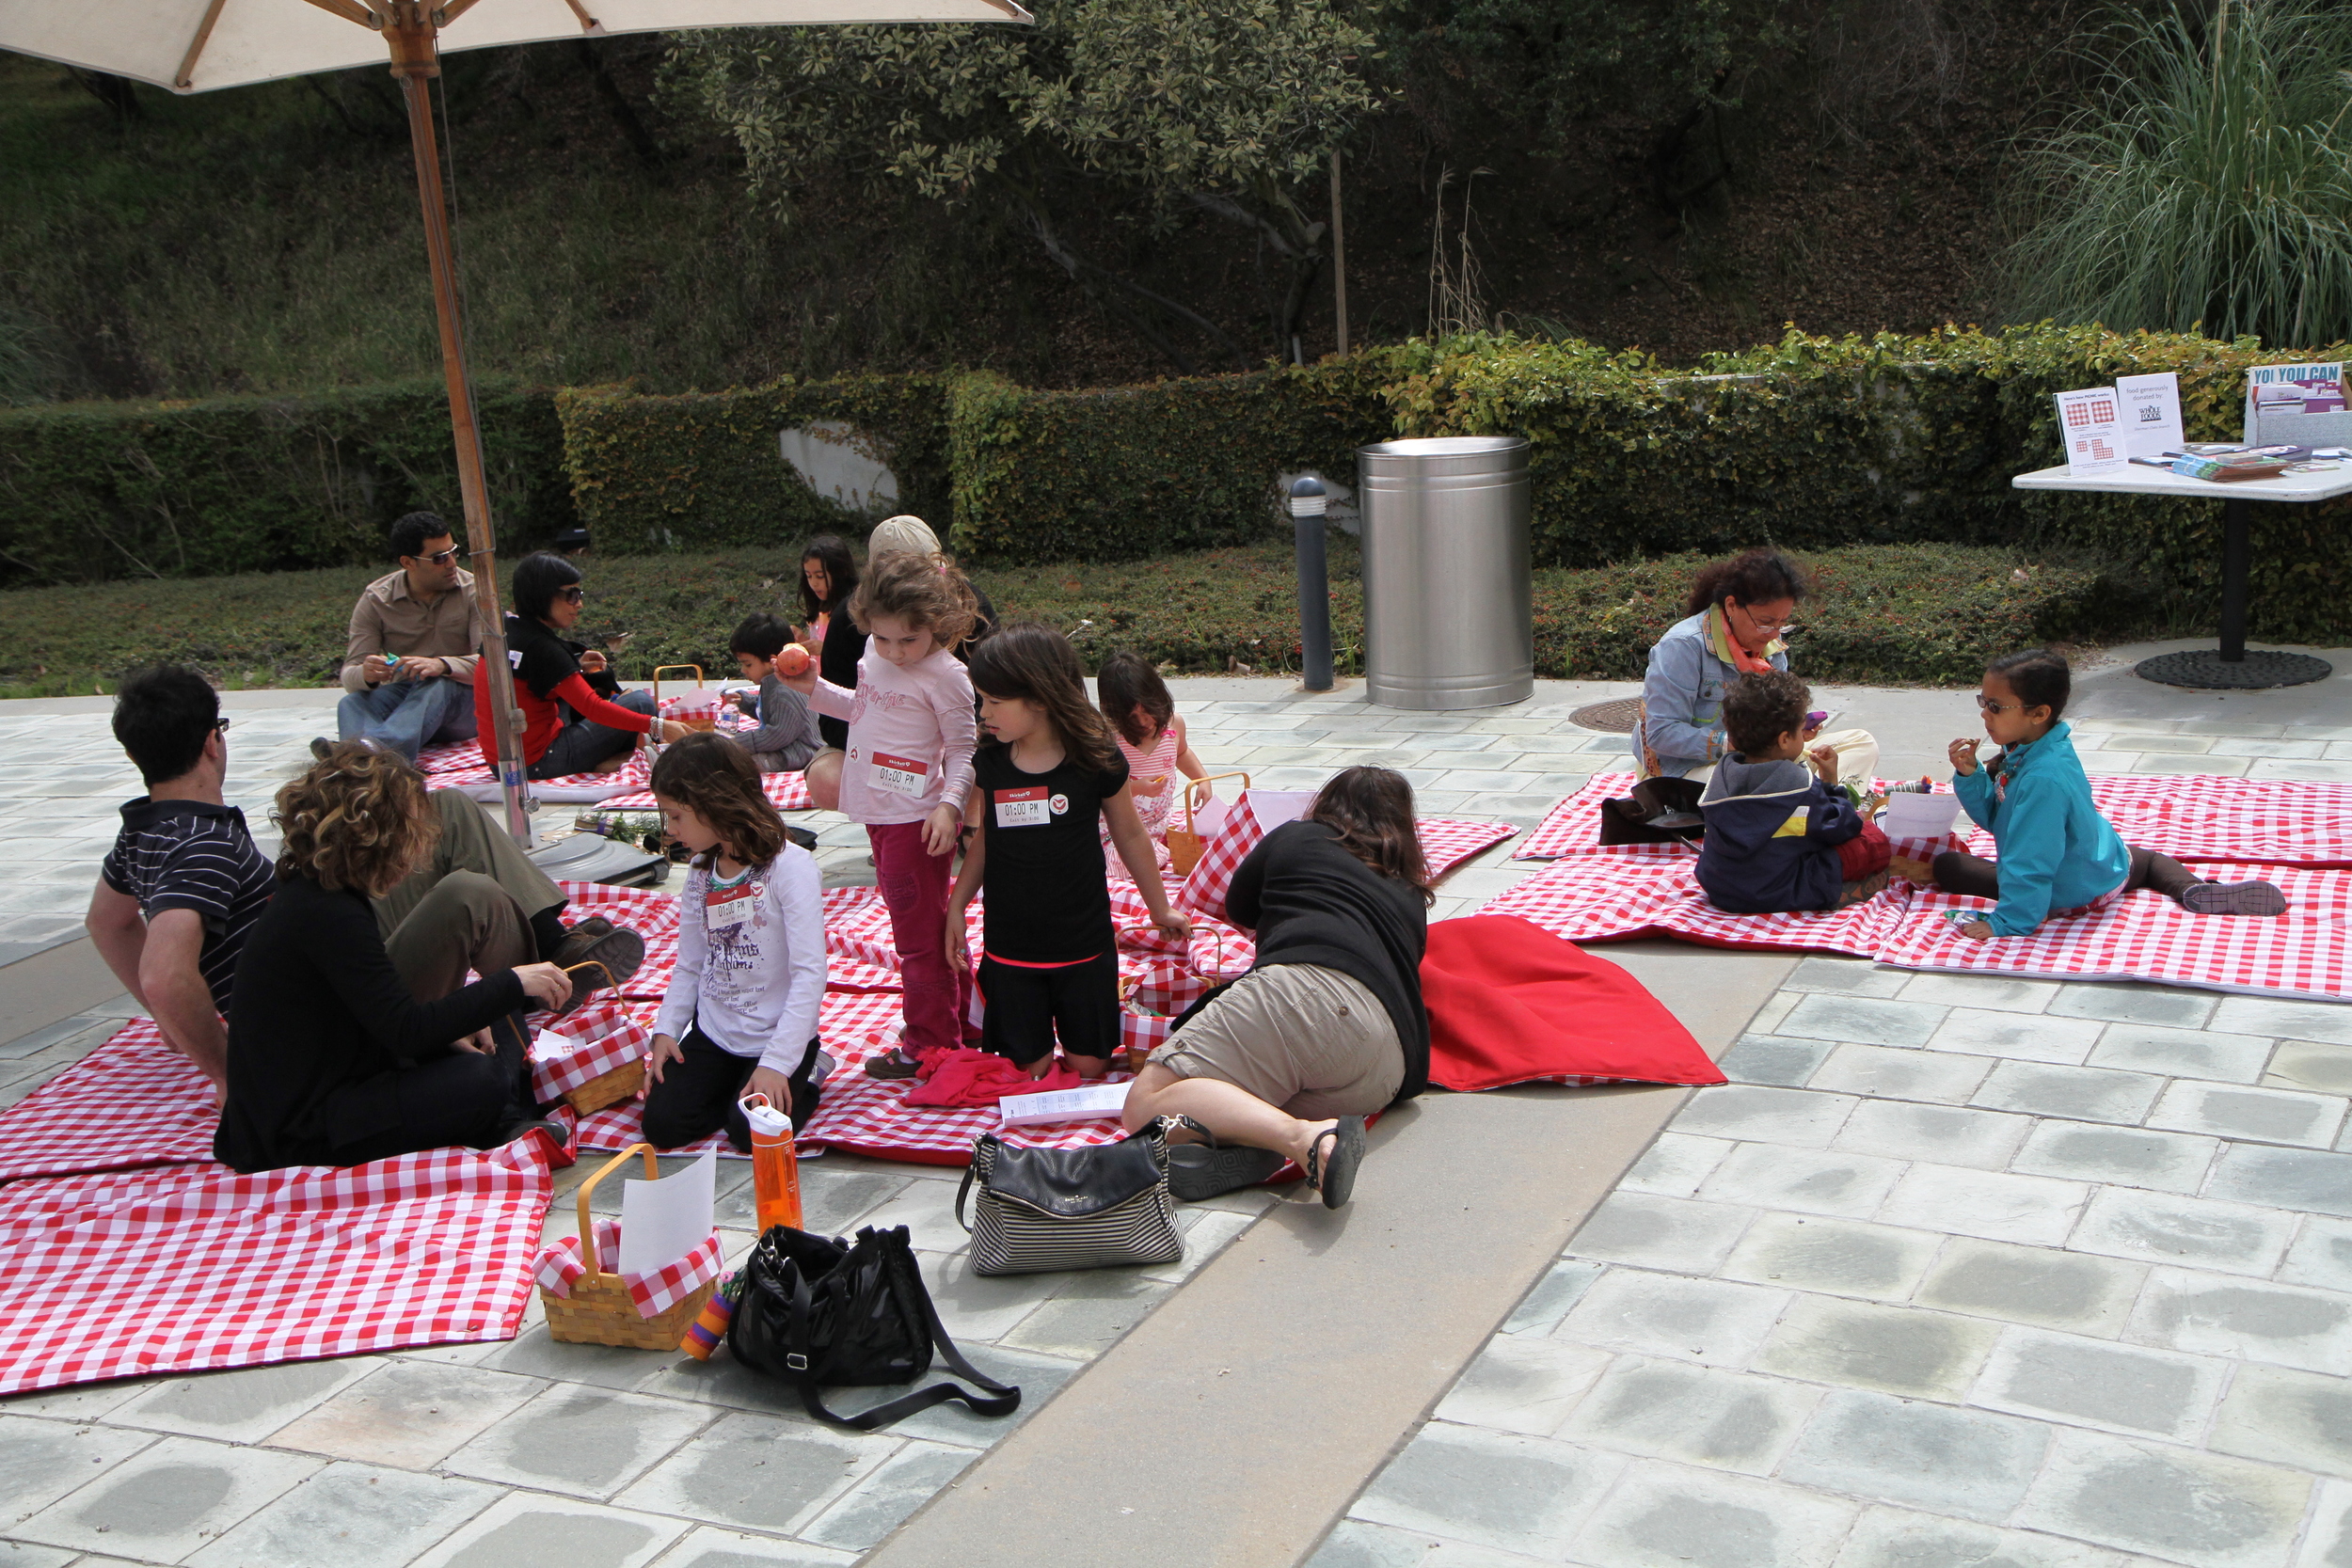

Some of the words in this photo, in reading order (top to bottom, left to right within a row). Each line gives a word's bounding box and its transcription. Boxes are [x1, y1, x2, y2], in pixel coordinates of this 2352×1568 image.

[2279, 367, 2306, 382] YOU
[2310, 366, 2338, 380] CAN
[2140, 385, 2168, 394] generously
[880, 768, 902, 783] 01:00
[905, 774, 915, 785] PM
[1005, 803, 1026, 816] 01:00
[1030, 803, 1038, 814] PM
[718, 902, 734, 917] 01:00
[737, 900, 745, 911] PM
